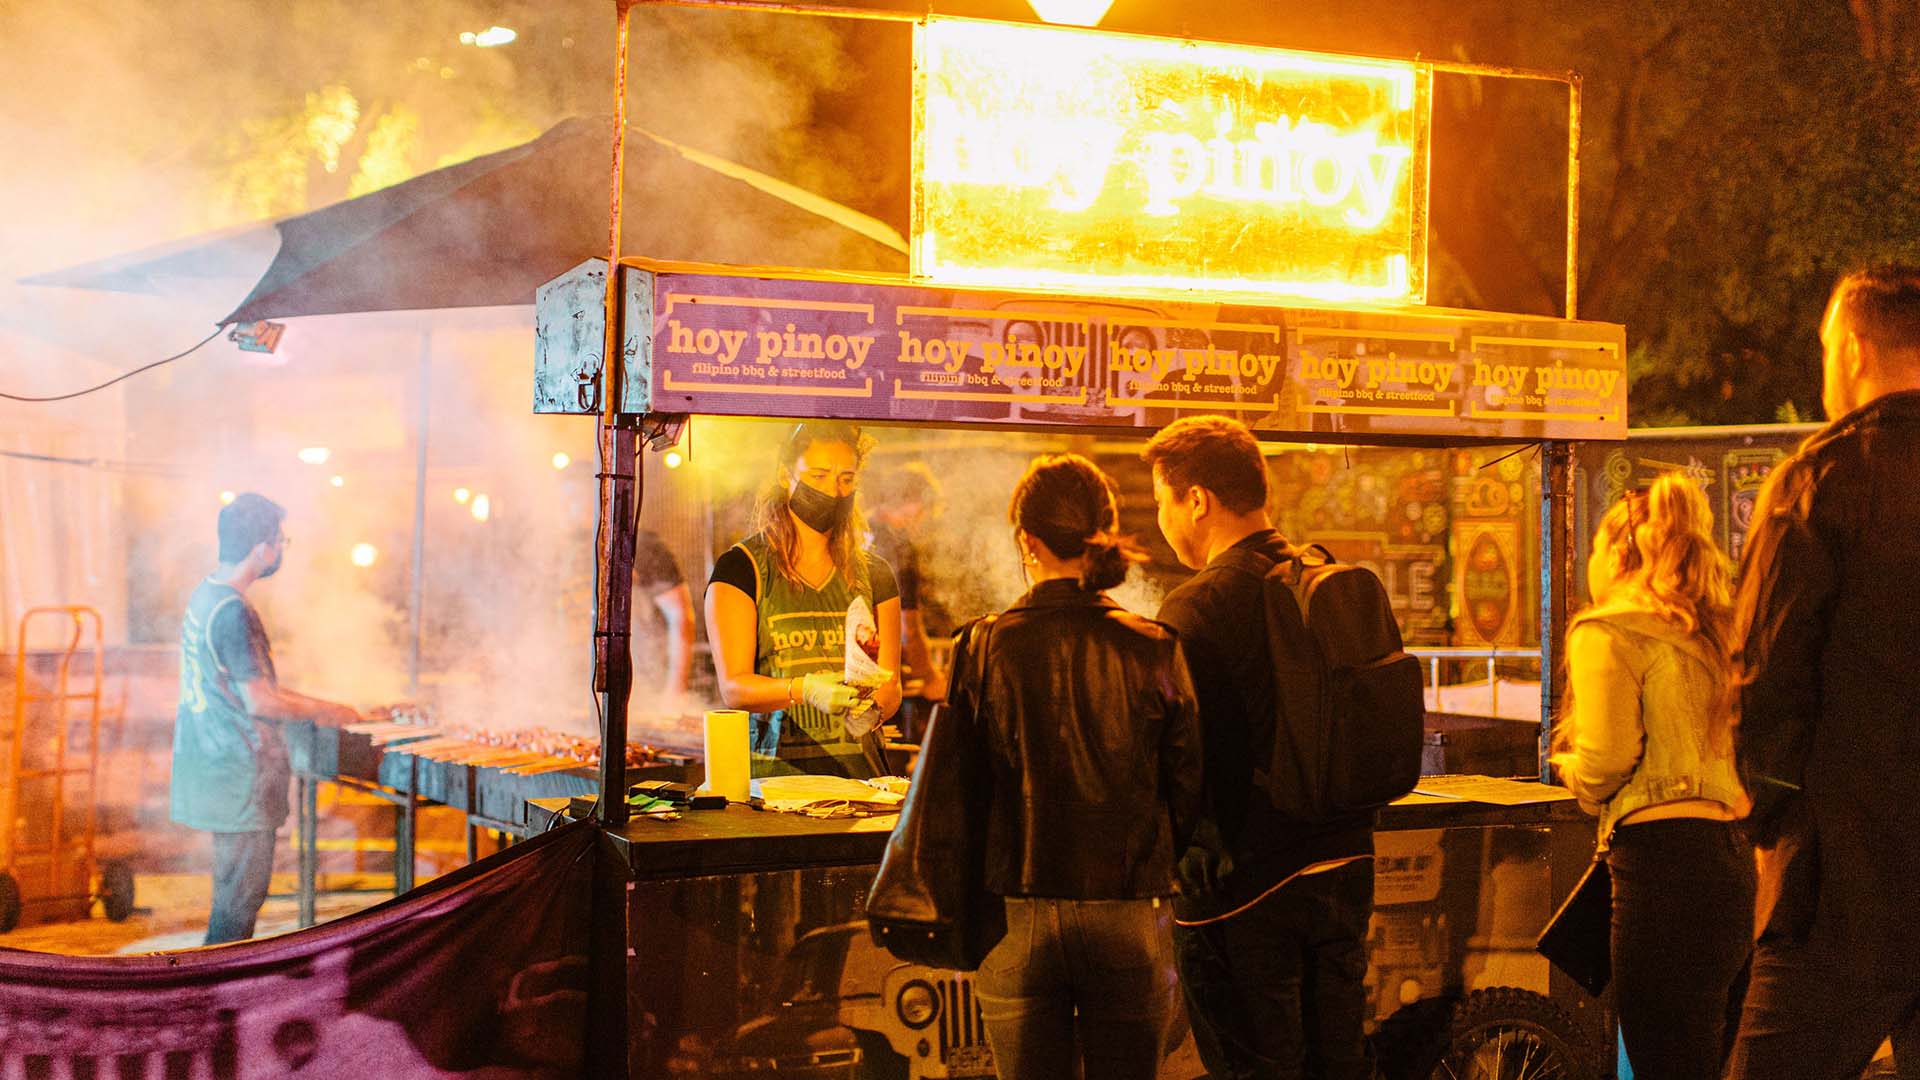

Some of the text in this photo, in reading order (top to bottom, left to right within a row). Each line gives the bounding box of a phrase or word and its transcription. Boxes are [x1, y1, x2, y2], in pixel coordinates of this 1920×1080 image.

[1141, 104, 1412, 229] pinoy
[667, 320, 875, 369] hoy pinoy
[898, 331, 1089, 378] hoy pinoy
[1108, 341, 1281, 386] hoy pinoy
[692, 362, 847, 380] filipino bbq & streetfood
[967, 373, 989, 387] bbq
[991, 374, 1002, 386] &
[1171, 381, 1191, 394] bbq
[1192, 382, 1203, 393] &
[1300, 350, 1457, 393] hoy pinoy
[1472, 358, 1620, 399] hoy pinoy
[1355, 388, 1375, 401] bbq
[1375, 390, 1385, 399] &
[1525, 395, 1543, 407] bbq
